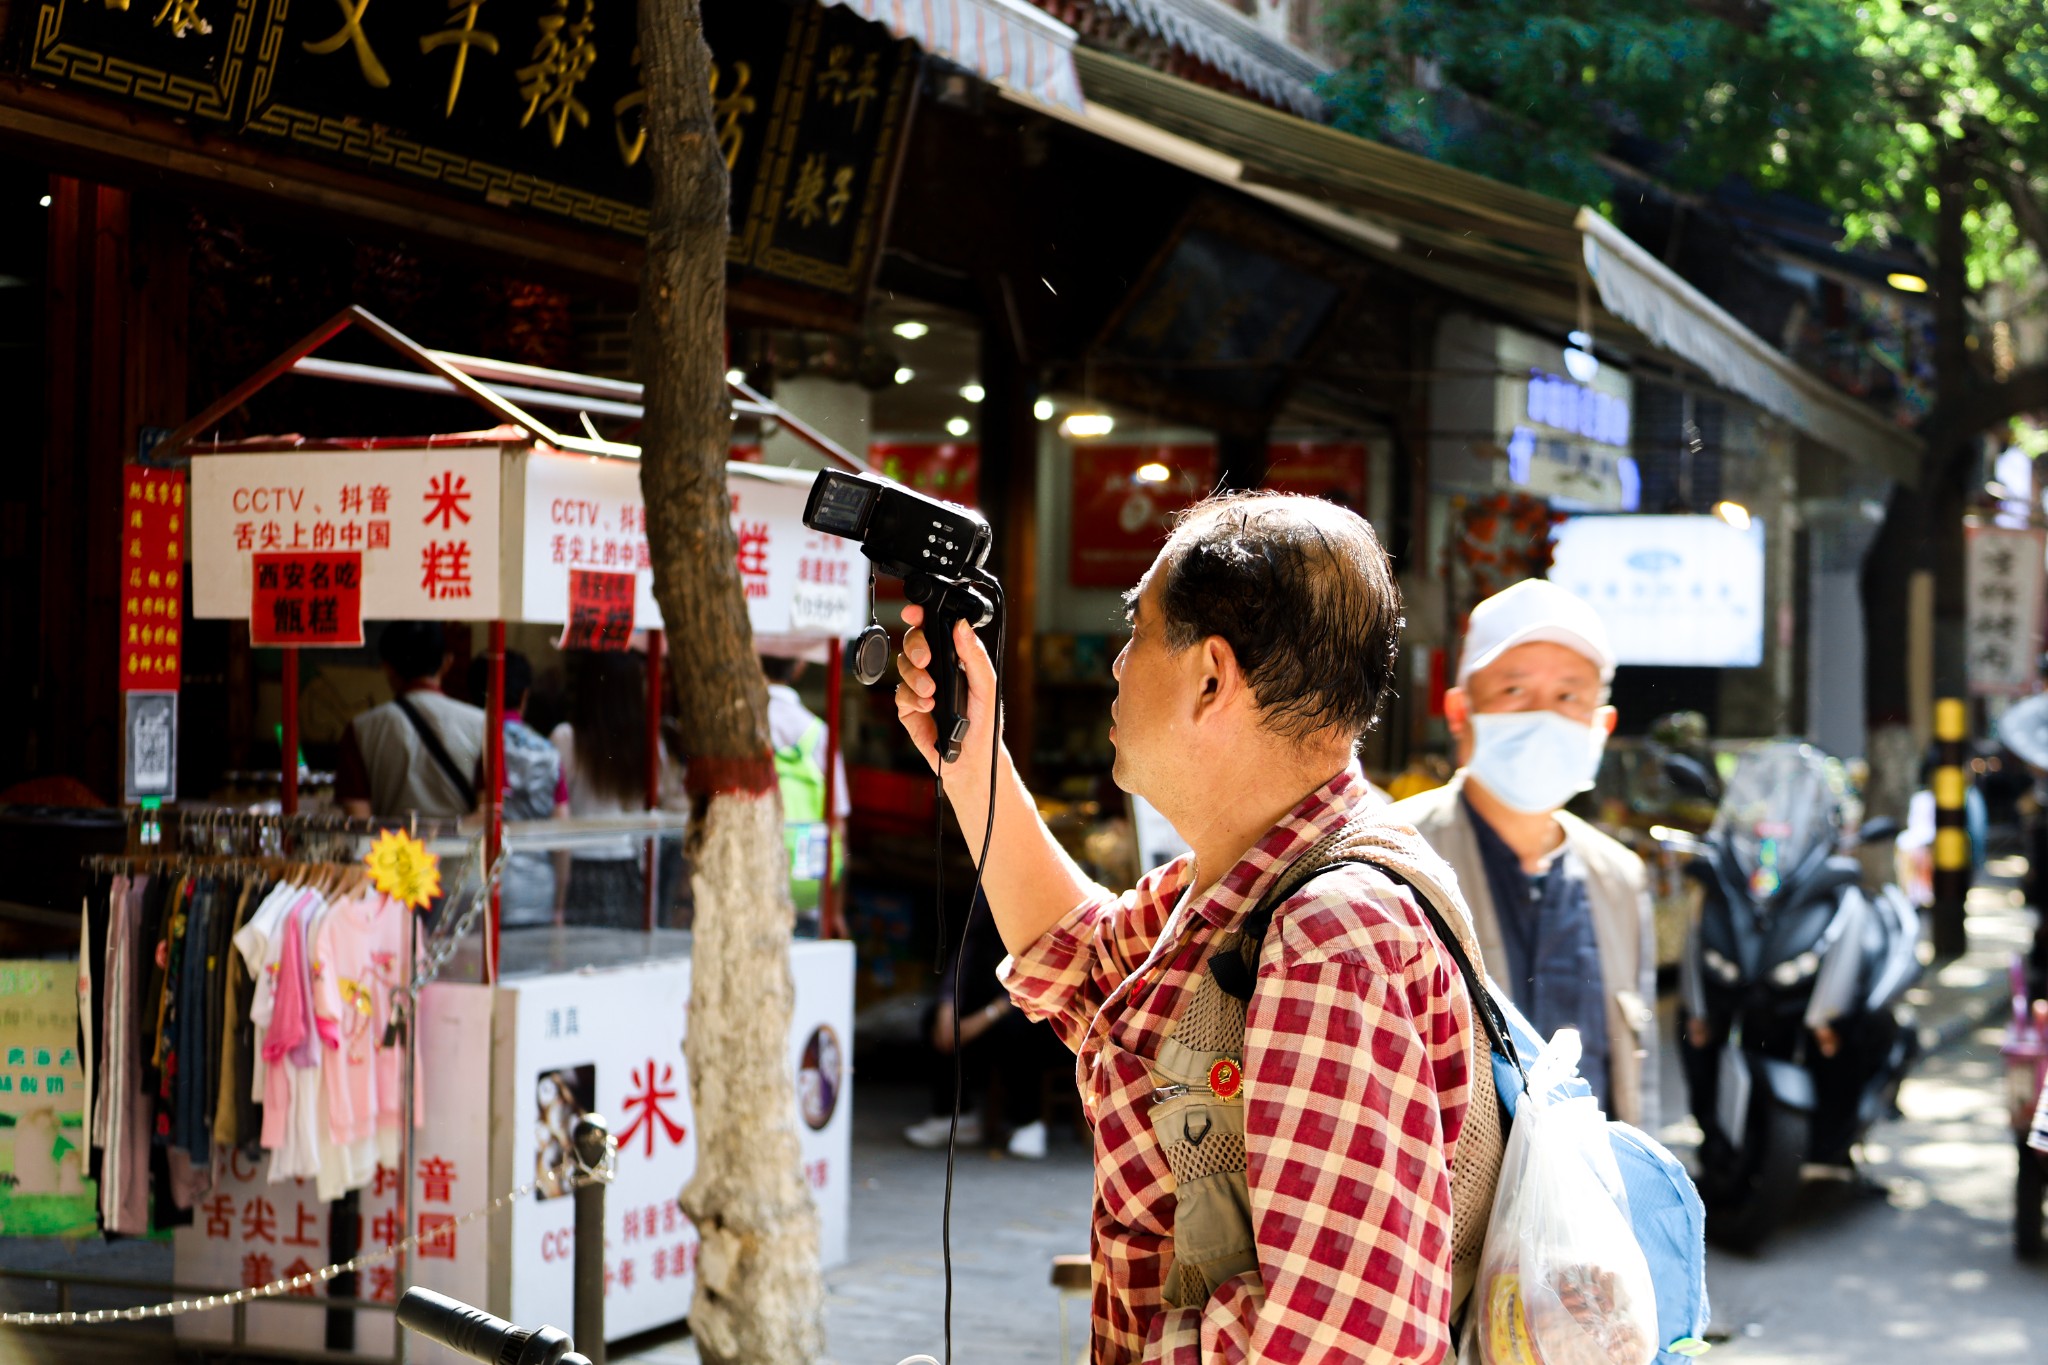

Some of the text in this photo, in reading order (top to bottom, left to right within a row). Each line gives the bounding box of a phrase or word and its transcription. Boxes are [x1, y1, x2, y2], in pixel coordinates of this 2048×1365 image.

[233, 519, 391, 550] 舌尖上的中国
[421, 470, 472, 600] 米糕
[257, 561, 357, 590] 西安名吃
[202, 1193, 456, 1260] 舌尖上中国
